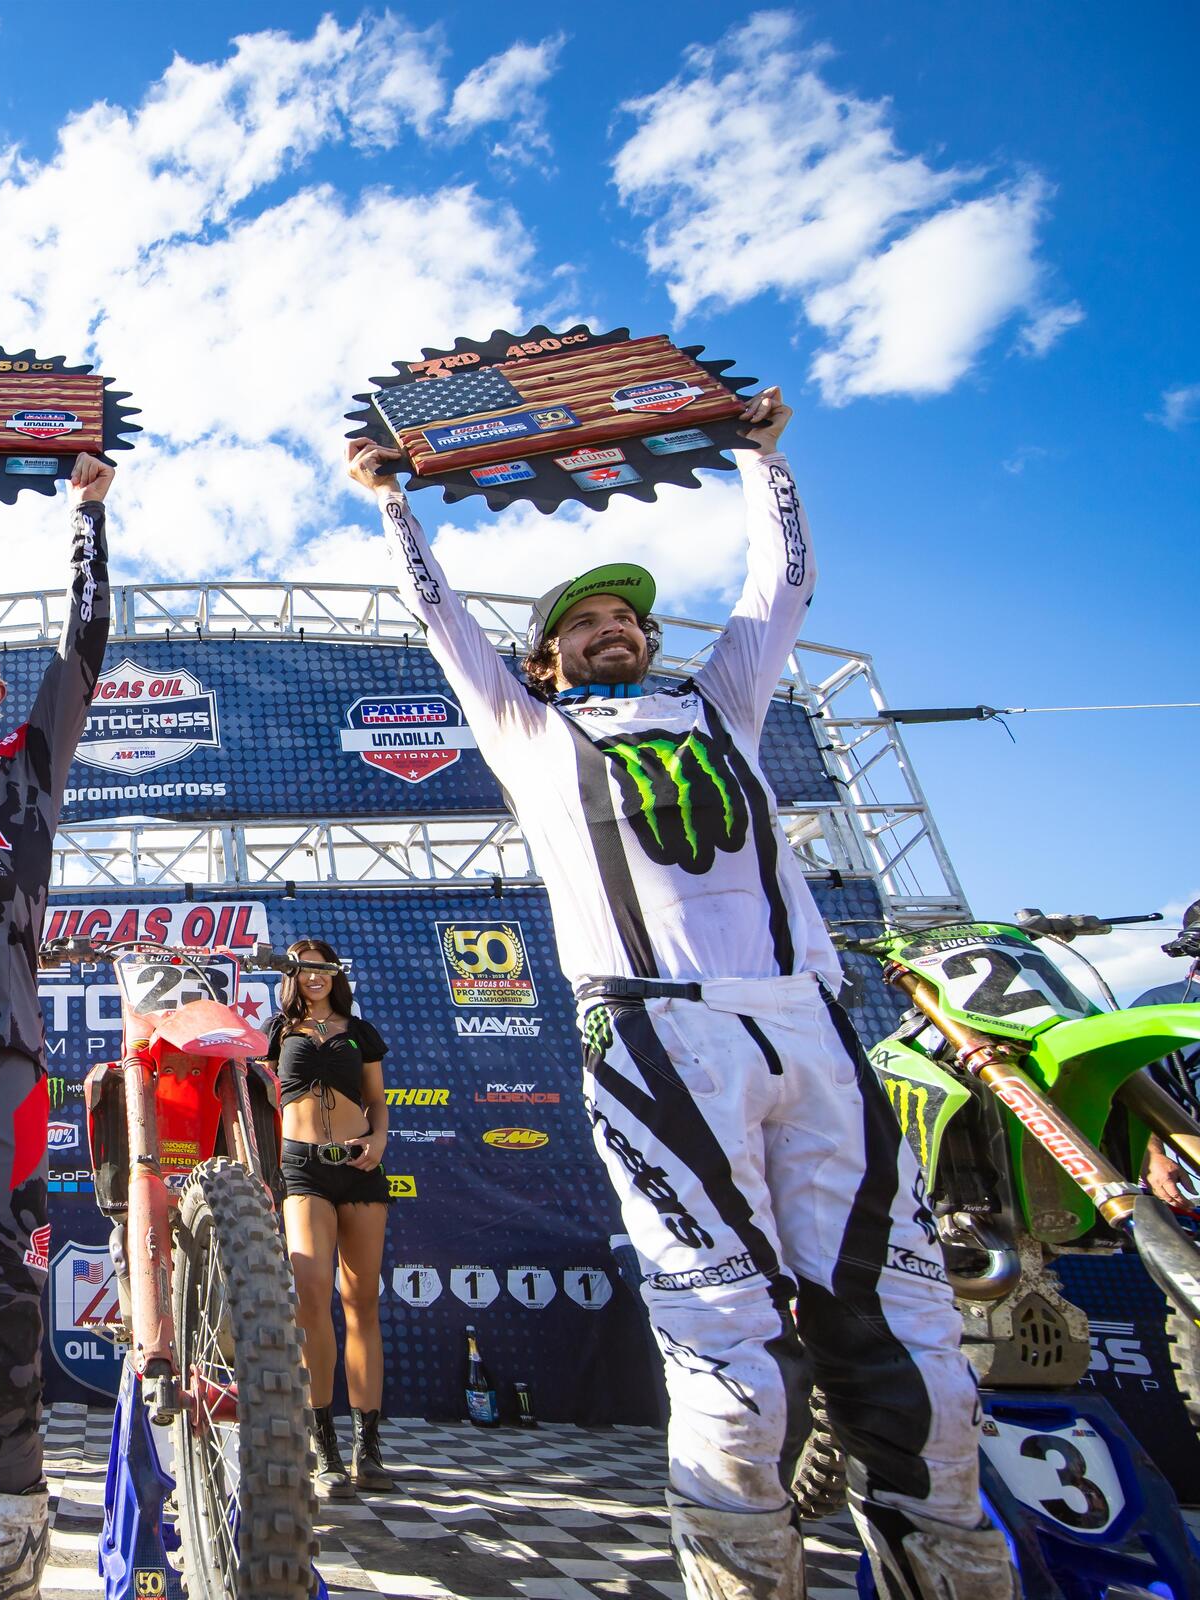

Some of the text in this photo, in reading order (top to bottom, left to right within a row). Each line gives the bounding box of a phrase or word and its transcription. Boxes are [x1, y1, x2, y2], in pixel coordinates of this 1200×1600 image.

[633, 391, 682, 405] UNADILLA
[534, 409, 566, 424] 50
[437, 424, 528, 446] MOTOCROSS
[453, 421, 503, 435] LUCAS OIL
[562, 450, 617, 466] EKLUND
[565, 576, 643, 601] Kawasaki
[91, 678, 185, 699] UCAS OIL
[362, 703, 445, 716] PARTS
[363, 714, 446, 723] UNLIMITED
[82, 726, 211, 738] AMPIONSHIP
[371, 731, 445, 747] UNADILLA
[111, 751, 140, 760] AMA
[373, 752, 449, 760] NATIONAL
[63, 782, 227, 806] promotocross
[45, 905, 259, 951] UCAS OIL
[940, 936, 1006, 951] LUCAS OIL
[453, 930, 518, 974] 50
[134, 965, 230, 1016] 23
[474, 980, 511, 988] LUCAS OIL
[476, 989, 531, 997] MOTOCROSS
[454, 1016, 543, 1034] MAVTV
[965, 1012, 1025, 1032] Kawasaki
[511, 1026, 535, 1036] PLUS
[199, 1038, 256, 1050] HONDA
[384, 1088, 450, 1106] THOR
[474, 1092, 561, 1105] LEGENDS
[47, 1128, 73, 1143] 00%
[388, 1130, 456, 1138] TENSE
[484, 1130, 548, 1144] FMF
[994, 1083, 1098, 1178] SHOWA
[162, 1142, 198, 1150] WORKS
[648, 1253, 757, 1290] Kawasaki
[407, 1270, 428, 1299] 1ST
[522, 1272, 542, 1301] 1ST
[64, 1341, 105, 1360] OIL
[1019, 1434, 1111, 1531] 3
[140, 1572, 163, 1595] 50
